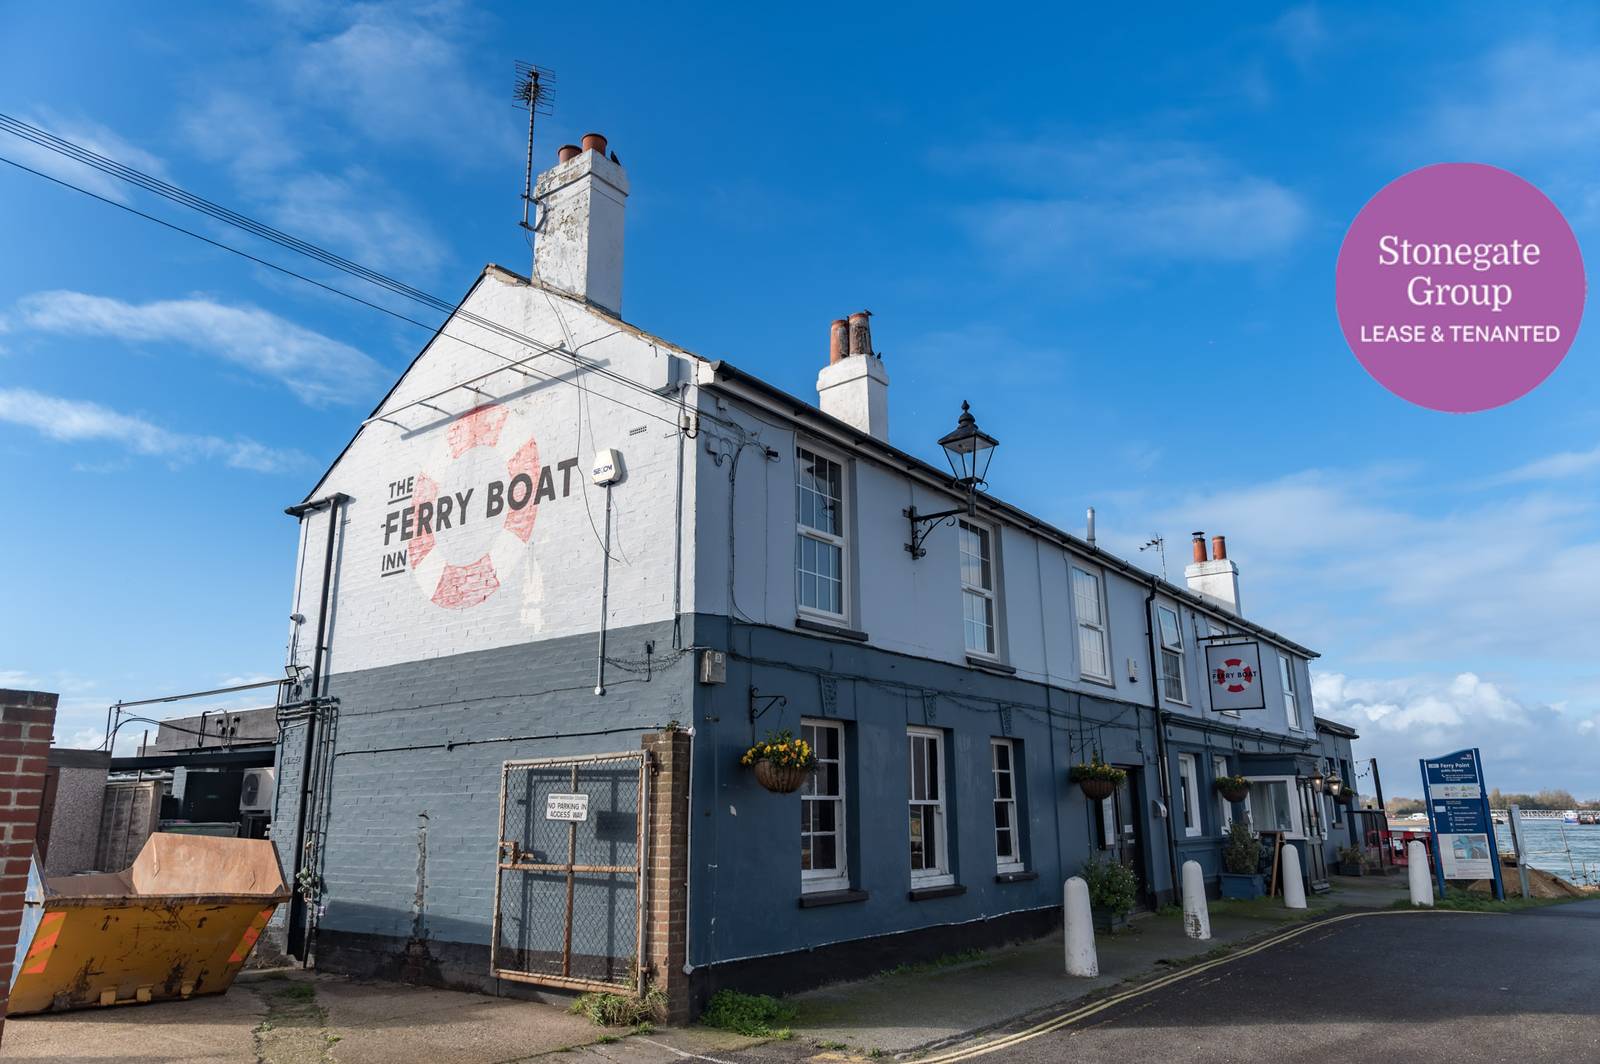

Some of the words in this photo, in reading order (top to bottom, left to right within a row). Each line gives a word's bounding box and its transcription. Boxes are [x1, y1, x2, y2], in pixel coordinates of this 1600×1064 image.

[593, 464, 613, 476] SEOM
[388, 476, 415, 499] THE
[384, 488, 474, 546] FERRY
[486, 457, 579, 518] BOAT
[381, 549, 408, 572] INN
[557, 802, 580, 810] PARKING
